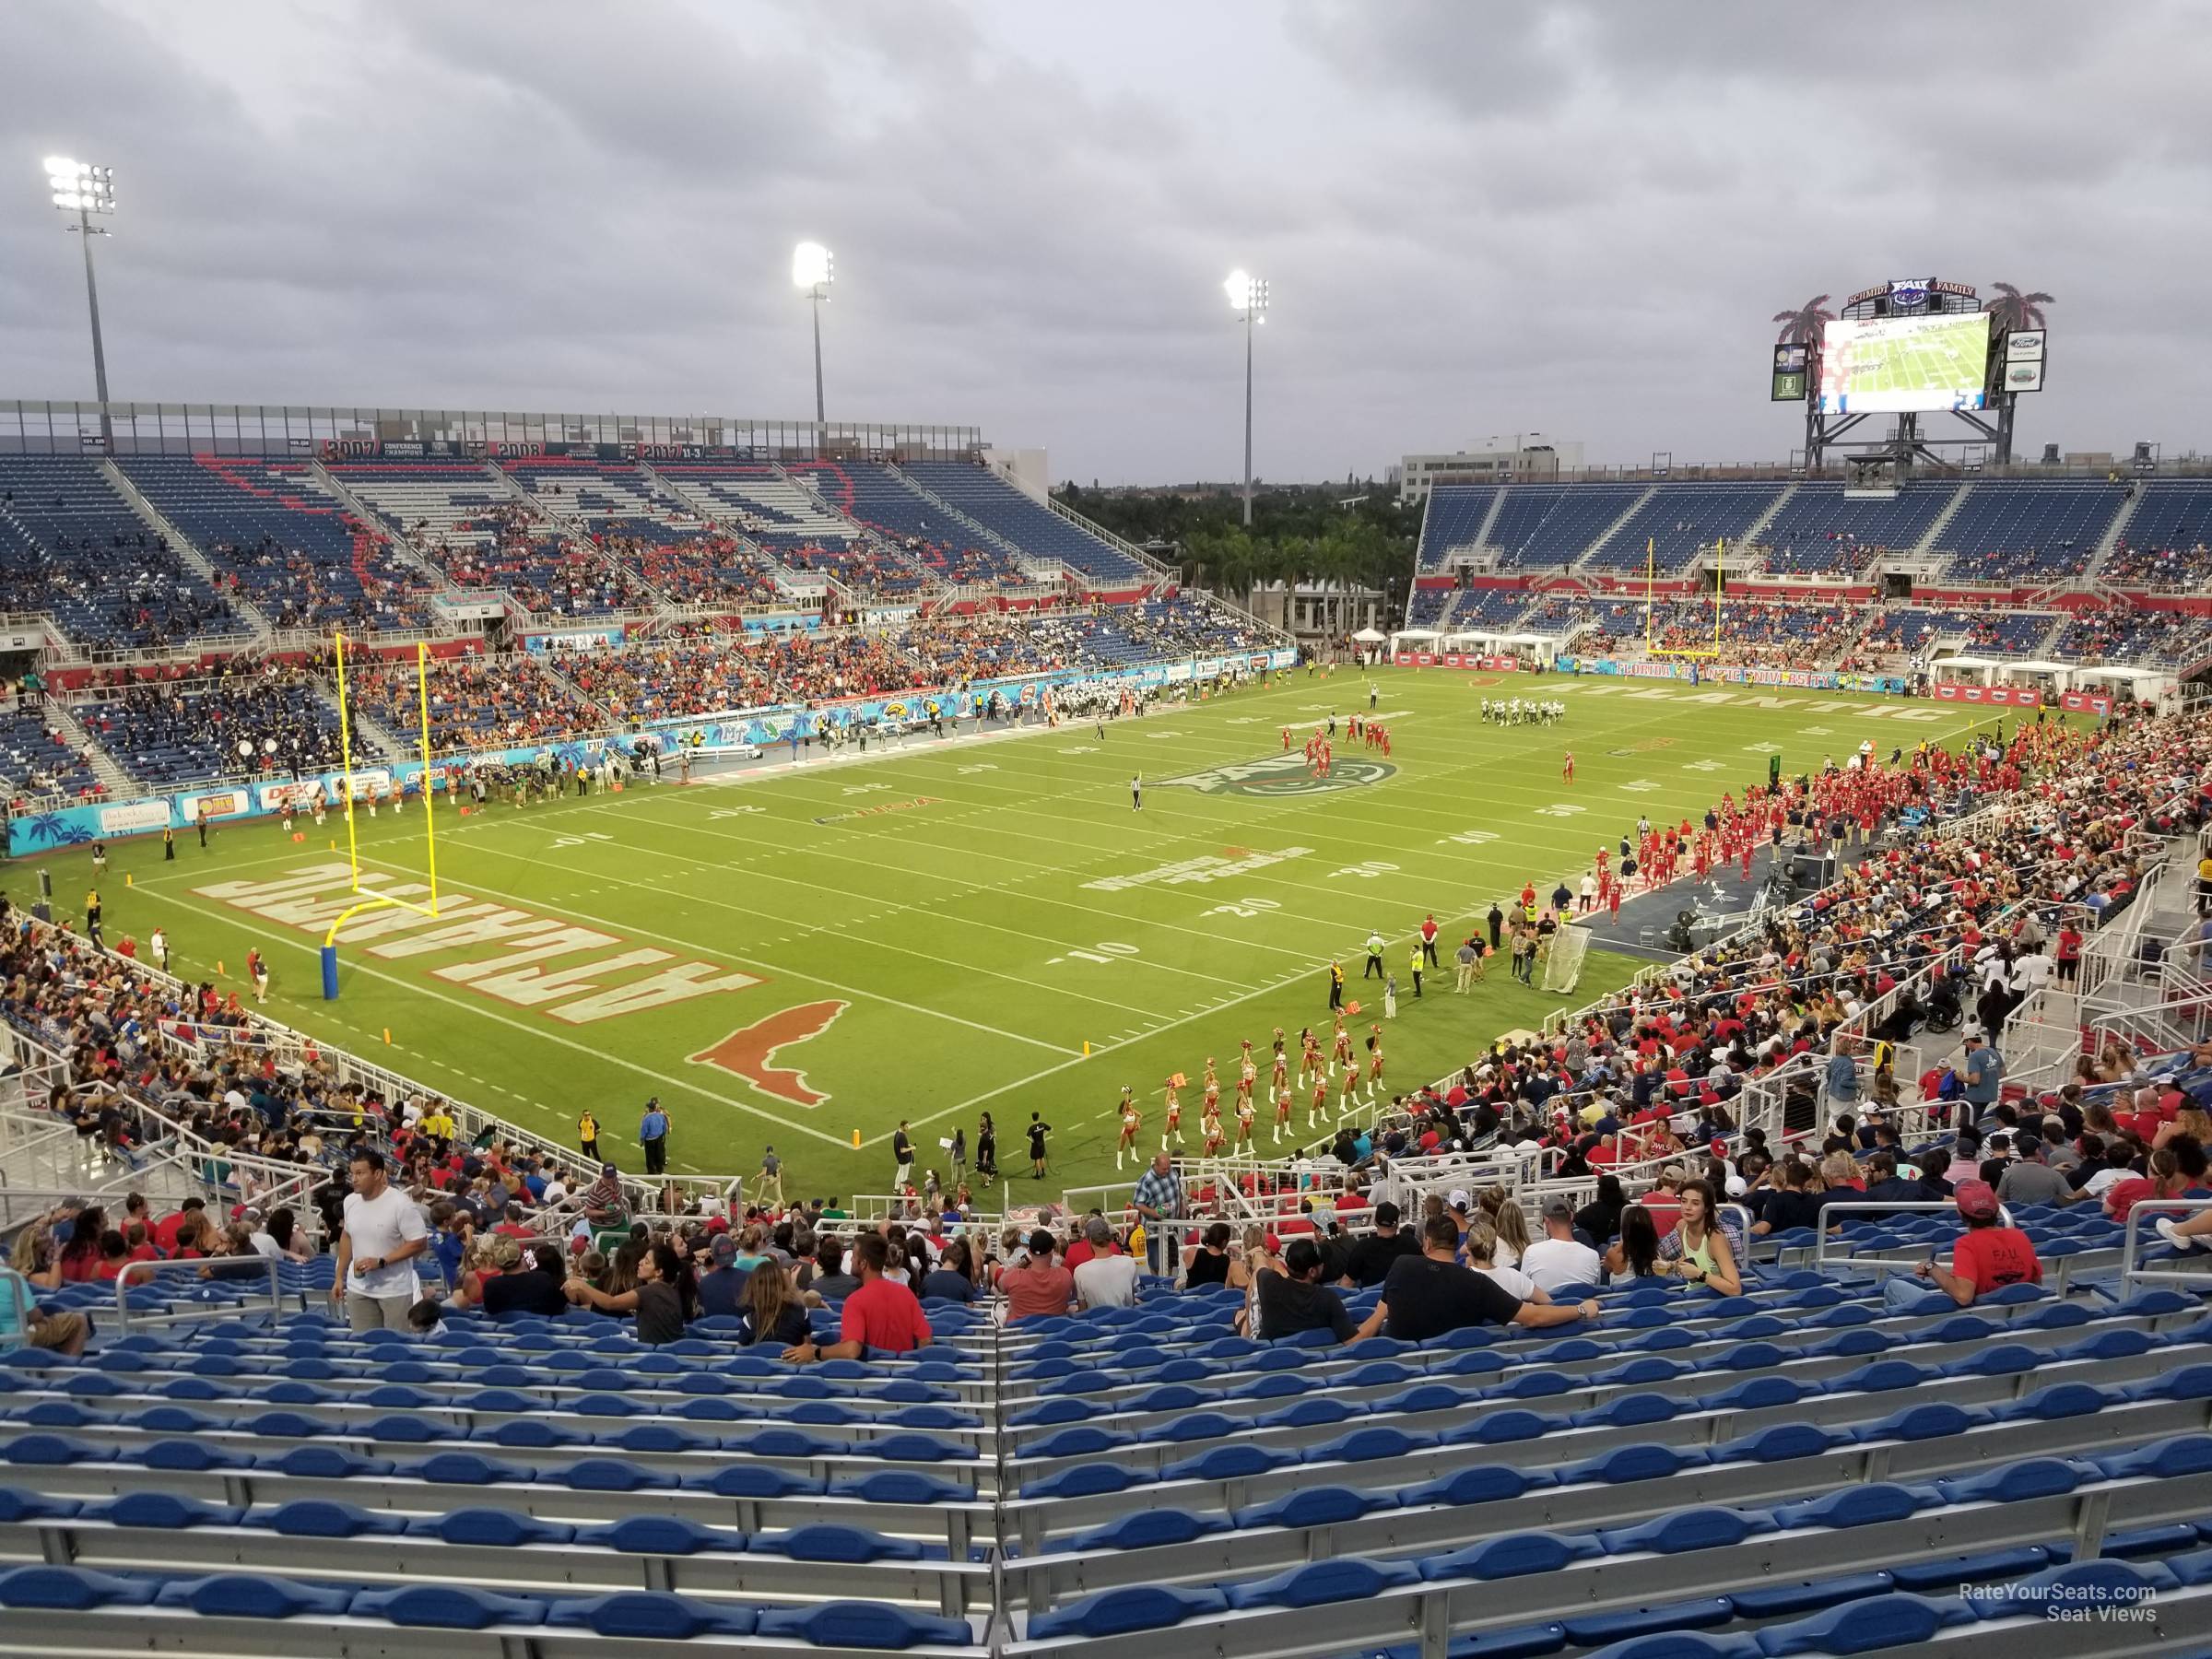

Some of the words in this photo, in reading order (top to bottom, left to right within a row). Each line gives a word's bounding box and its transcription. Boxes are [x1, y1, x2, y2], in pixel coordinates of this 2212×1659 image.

[1891, 279, 1930, 293] FAU
[1936, 281, 1974, 296] FAMILY
[1848, 286, 1888, 305] SCHMIDT
[2015, 338, 2036, 347] Ford
[326, 440, 374, 455] 2007
[498, 442, 541, 456] 2008
[643, 444, 681, 458] 2017
[682, 448, 701, 458] 11-3
[1909, 656, 1924, 668] 25
[1145, 669, 1163, 682] Field
[1618, 662, 1671, 677] FLORIDA
[1524, 682, 1959, 722] ATLANTIC
[587, 741, 603, 750] FIU
[710, 805, 767, 818] 20
[1534, 804, 1587, 817] 50
[556, 831, 615, 847] 10
[1448, 830, 1501, 845] 40
[1339, 861, 1401, 877] 30
[1214, 898, 1283, 918] 20
[190, 862, 766, 1025] ATLANTIC
[1067, 942, 1141, 964] 10
[1557, 1080, 1567, 1091] 10
[1992, 1247, 2017, 1260] FAU
